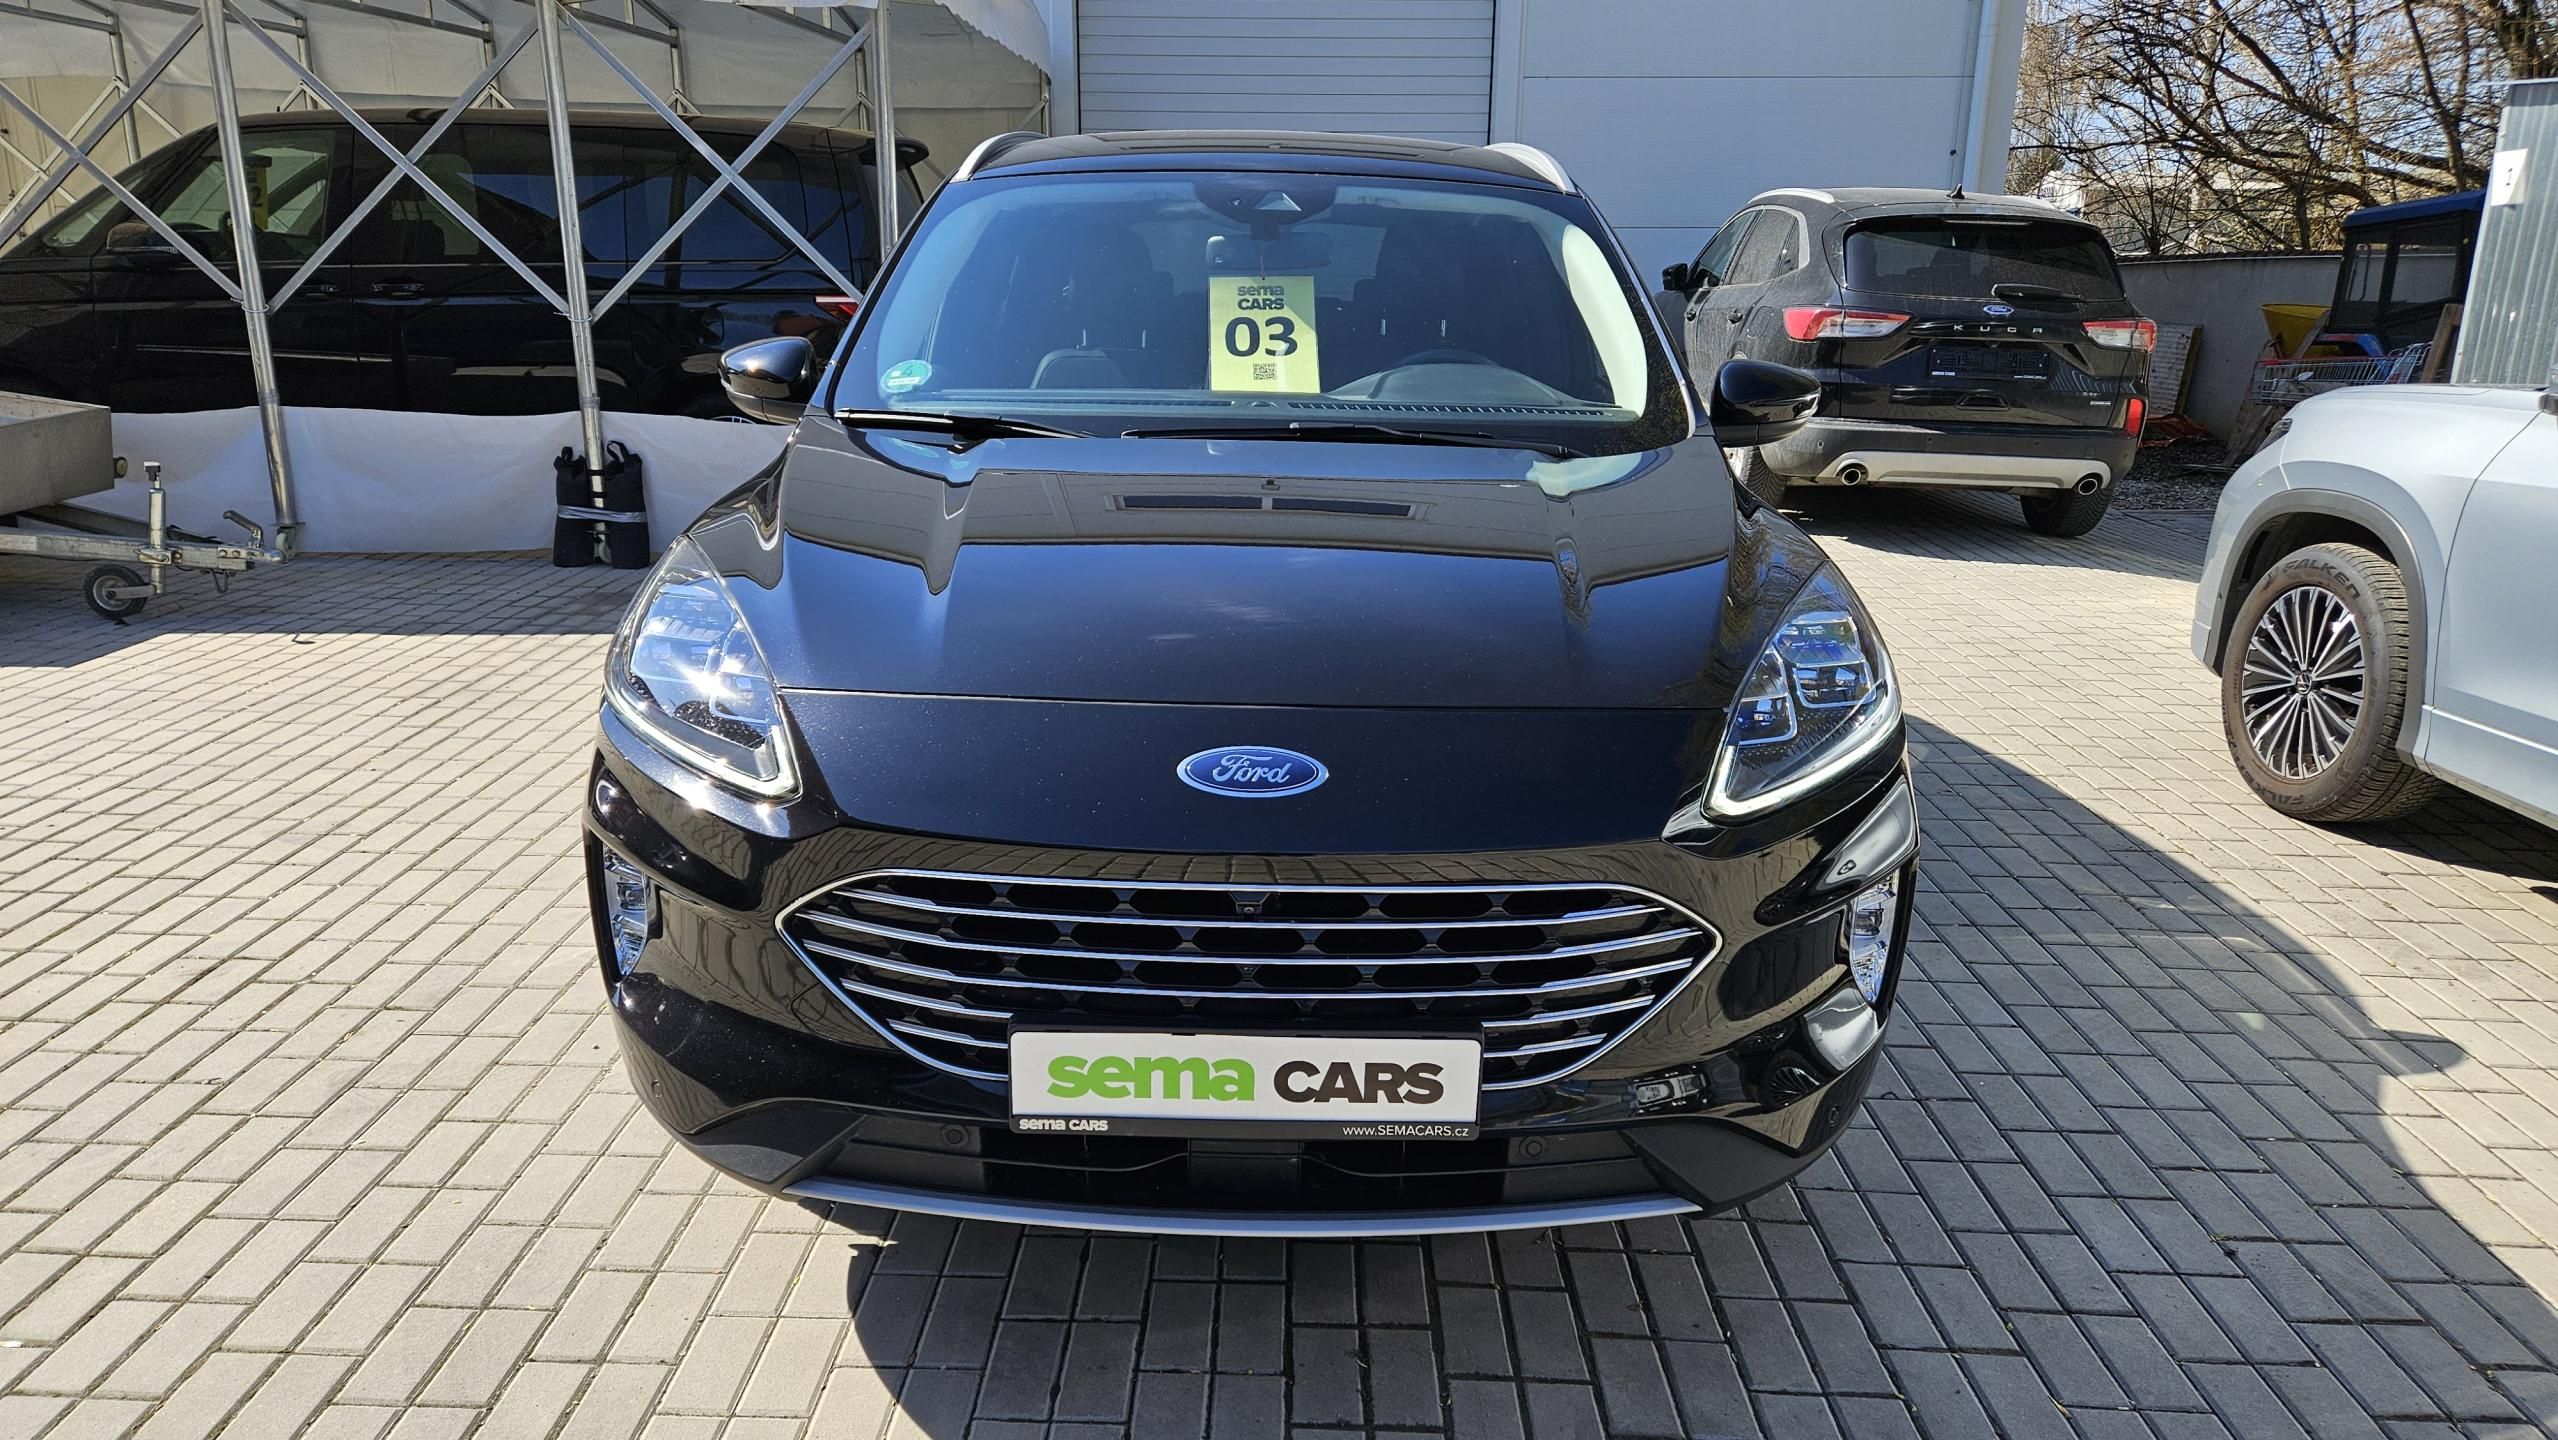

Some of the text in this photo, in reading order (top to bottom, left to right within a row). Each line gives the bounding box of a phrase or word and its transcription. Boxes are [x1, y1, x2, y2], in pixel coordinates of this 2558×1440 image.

[1237, 285, 1285, 296] sema
[1237, 298, 1285, 310] CARS
[1954, 324, 2043, 334] KUGA
[1225, 316, 1298, 357] 03
[2284, 558, 2361, 601] FALKEN
[1212, 754, 1293, 784] Ford
[1046, 1055, 1445, 1105] sema CARS
[1019, 1118, 1109, 1132] sema CARS
[1342, 1124, 1469, 1138] www.SEMACARS.cz
